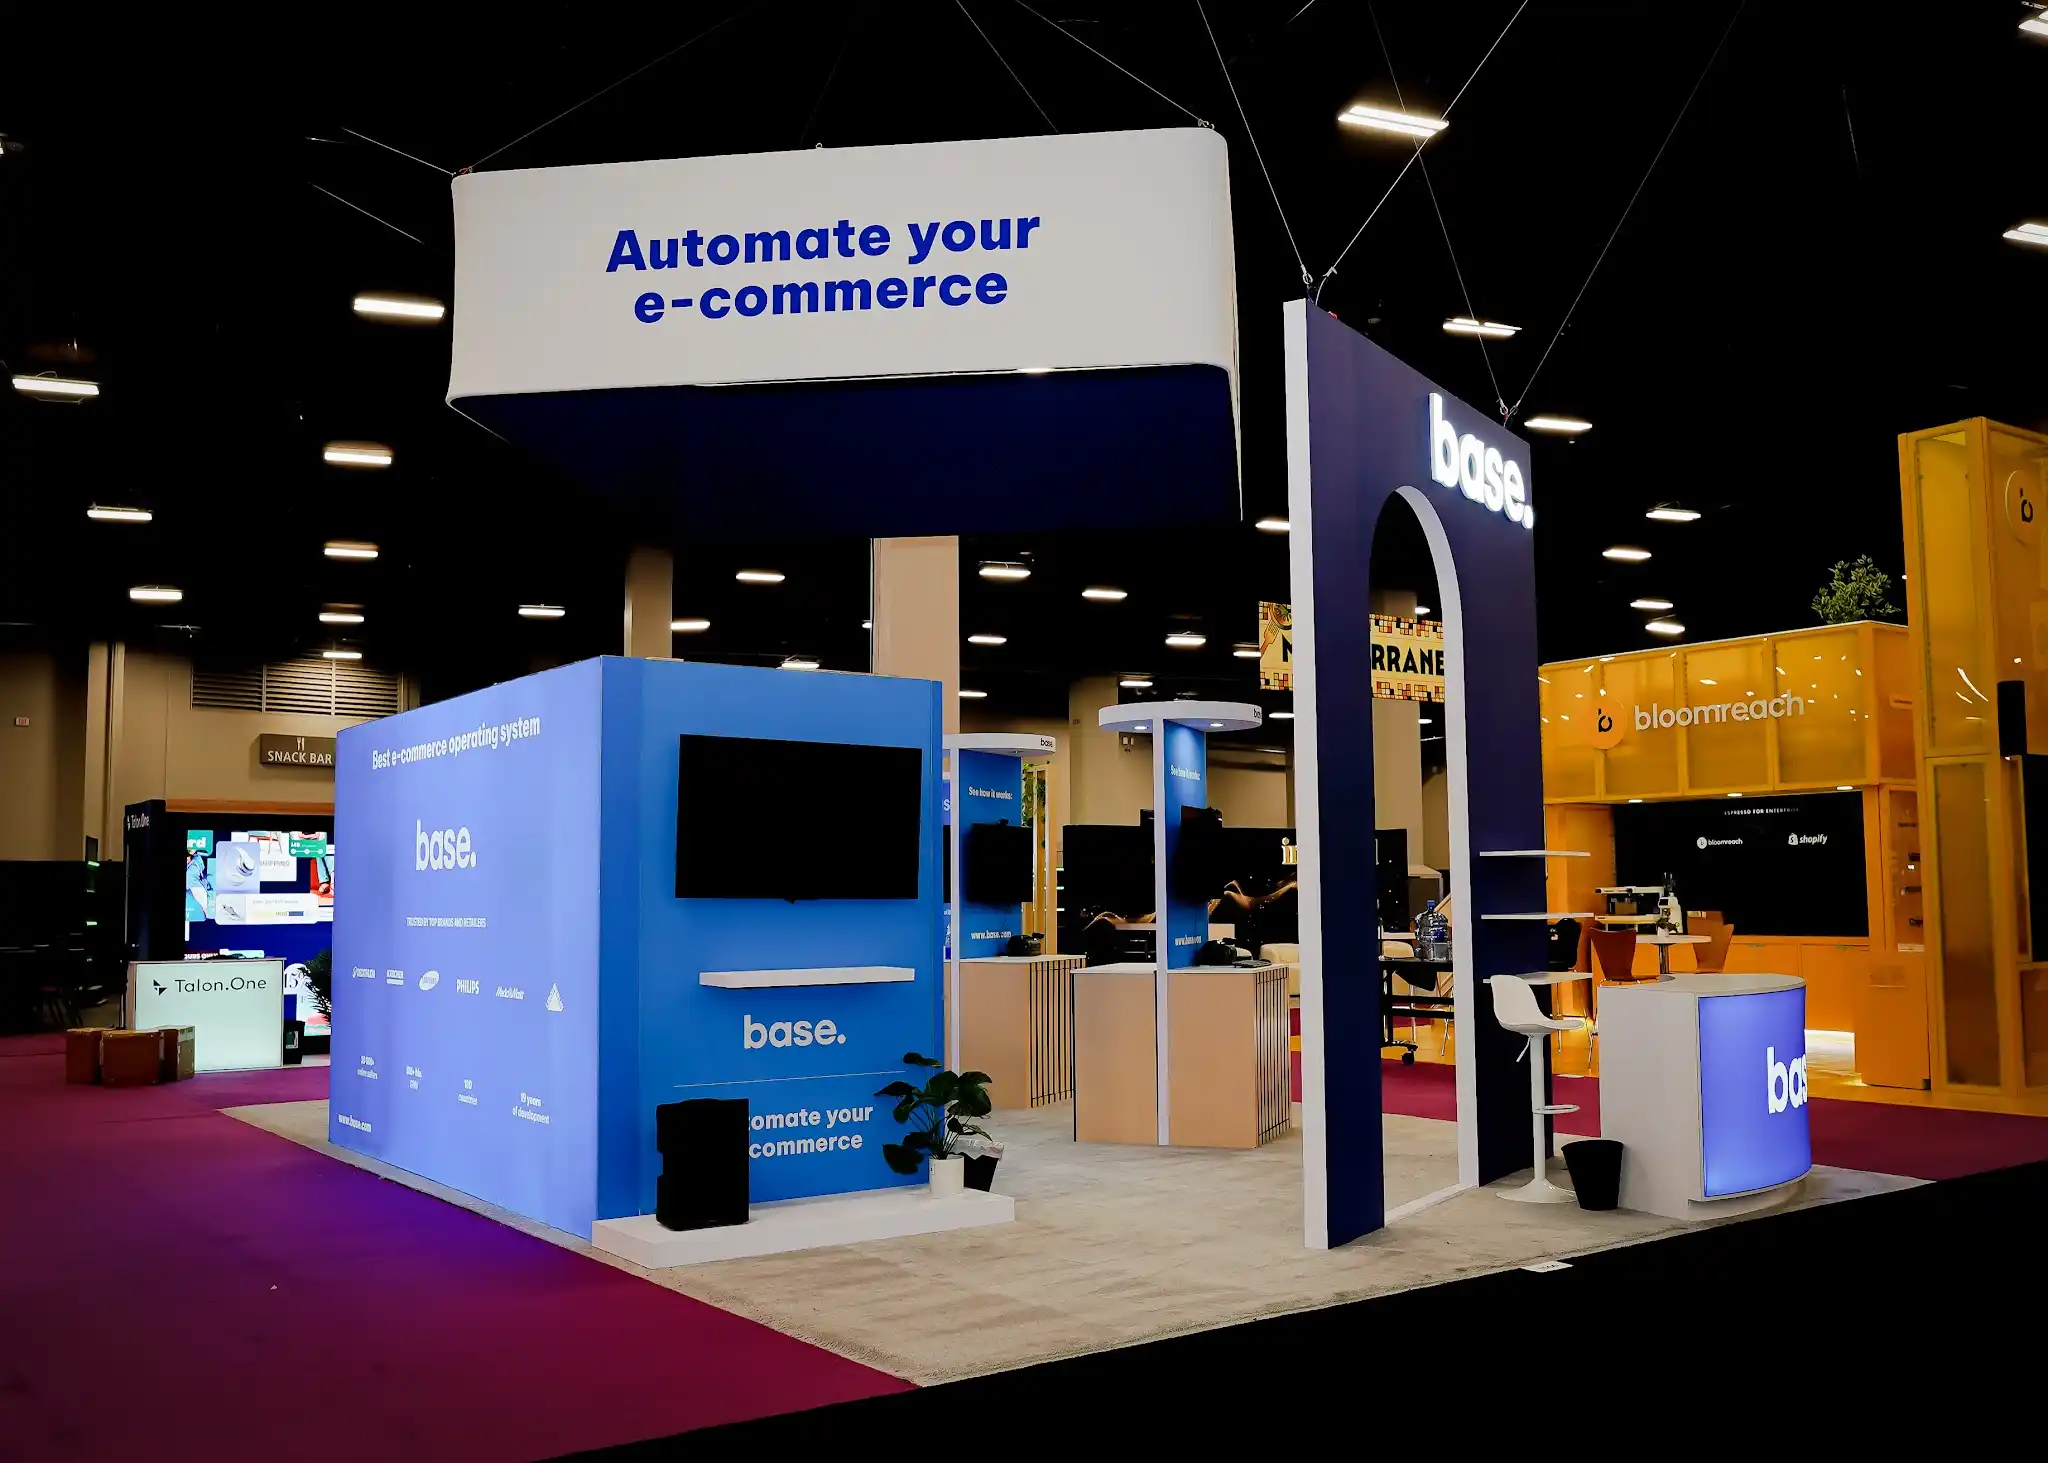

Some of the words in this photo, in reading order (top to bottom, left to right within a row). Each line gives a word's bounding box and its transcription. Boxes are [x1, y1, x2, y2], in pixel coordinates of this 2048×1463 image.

[606, 219, 890, 272] Automate
[907, 216, 1040, 264] your
[634, 271, 1008, 323] e-commerce
[1429, 393, 1534, 529] base.
[1634, 689, 1805, 730] bloomreach
[372, 750, 391, 770] Best
[391, 739, 447, 766] e-commerce
[448, 722, 498, 757] operating
[500, 716, 540, 747] system
[267, 751, 306, 763] SNACK
[309, 752, 332, 764] BAR
[968, 786, 980, 797] See
[980, 787, 990, 798] how
[416, 819, 477, 870] base.
[1708, 838, 1743, 846] bloomreach
[1799, 834, 1828, 845] shopify
[971, 930, 1011, 940] www.base.com
[175, 976, 267, 993] Talon.One
[456, 979, 480, 994] PHILIPS
[743, 1014, 847, 1049] base.
[1767, 1046, 1808, 1114] bas
[526, 1096, 541, 1107] years
[518, 1107, 550, 1124] development
[749, 1108, 821, 1131] omate
[826, 1104, 873, 1129] your
[749, 1134, 863, 1159] commerce
